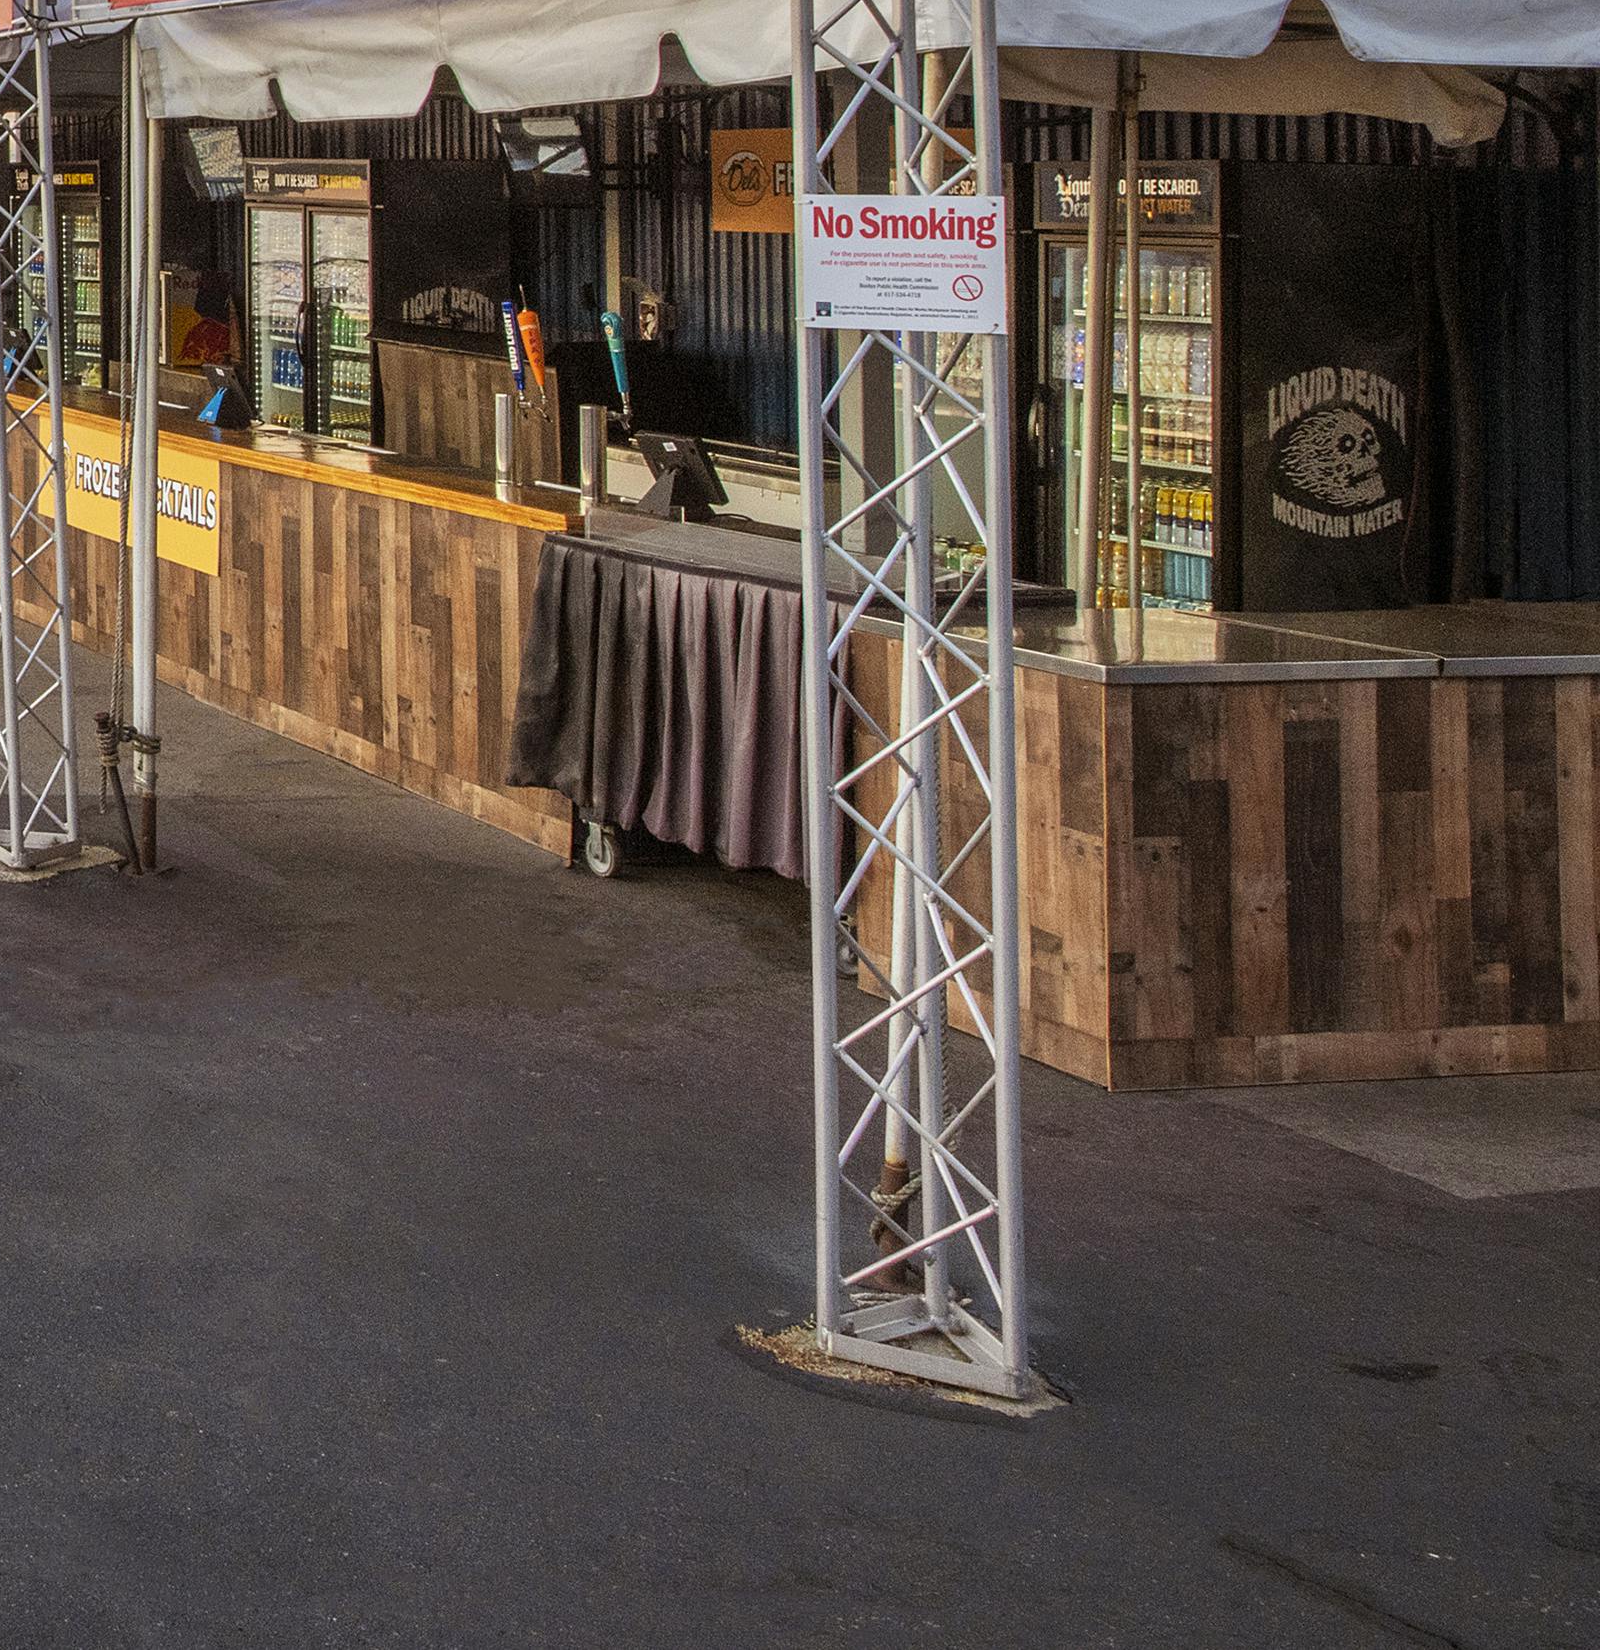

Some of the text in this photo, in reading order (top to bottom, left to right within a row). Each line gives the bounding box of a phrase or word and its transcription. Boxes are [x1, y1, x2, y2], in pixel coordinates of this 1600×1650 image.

[1144, 179, 1157, 195] BE
[812, 205, 997, 249] No Smoking
[502, 311, 520, 371] BUD LIGHT
[1268, 366, 1407, 446] LIQUID DEATH
[75, 453, 128, 500] FROZE
[1272, 492, 1405, 539] MOUNTAIN WATER
